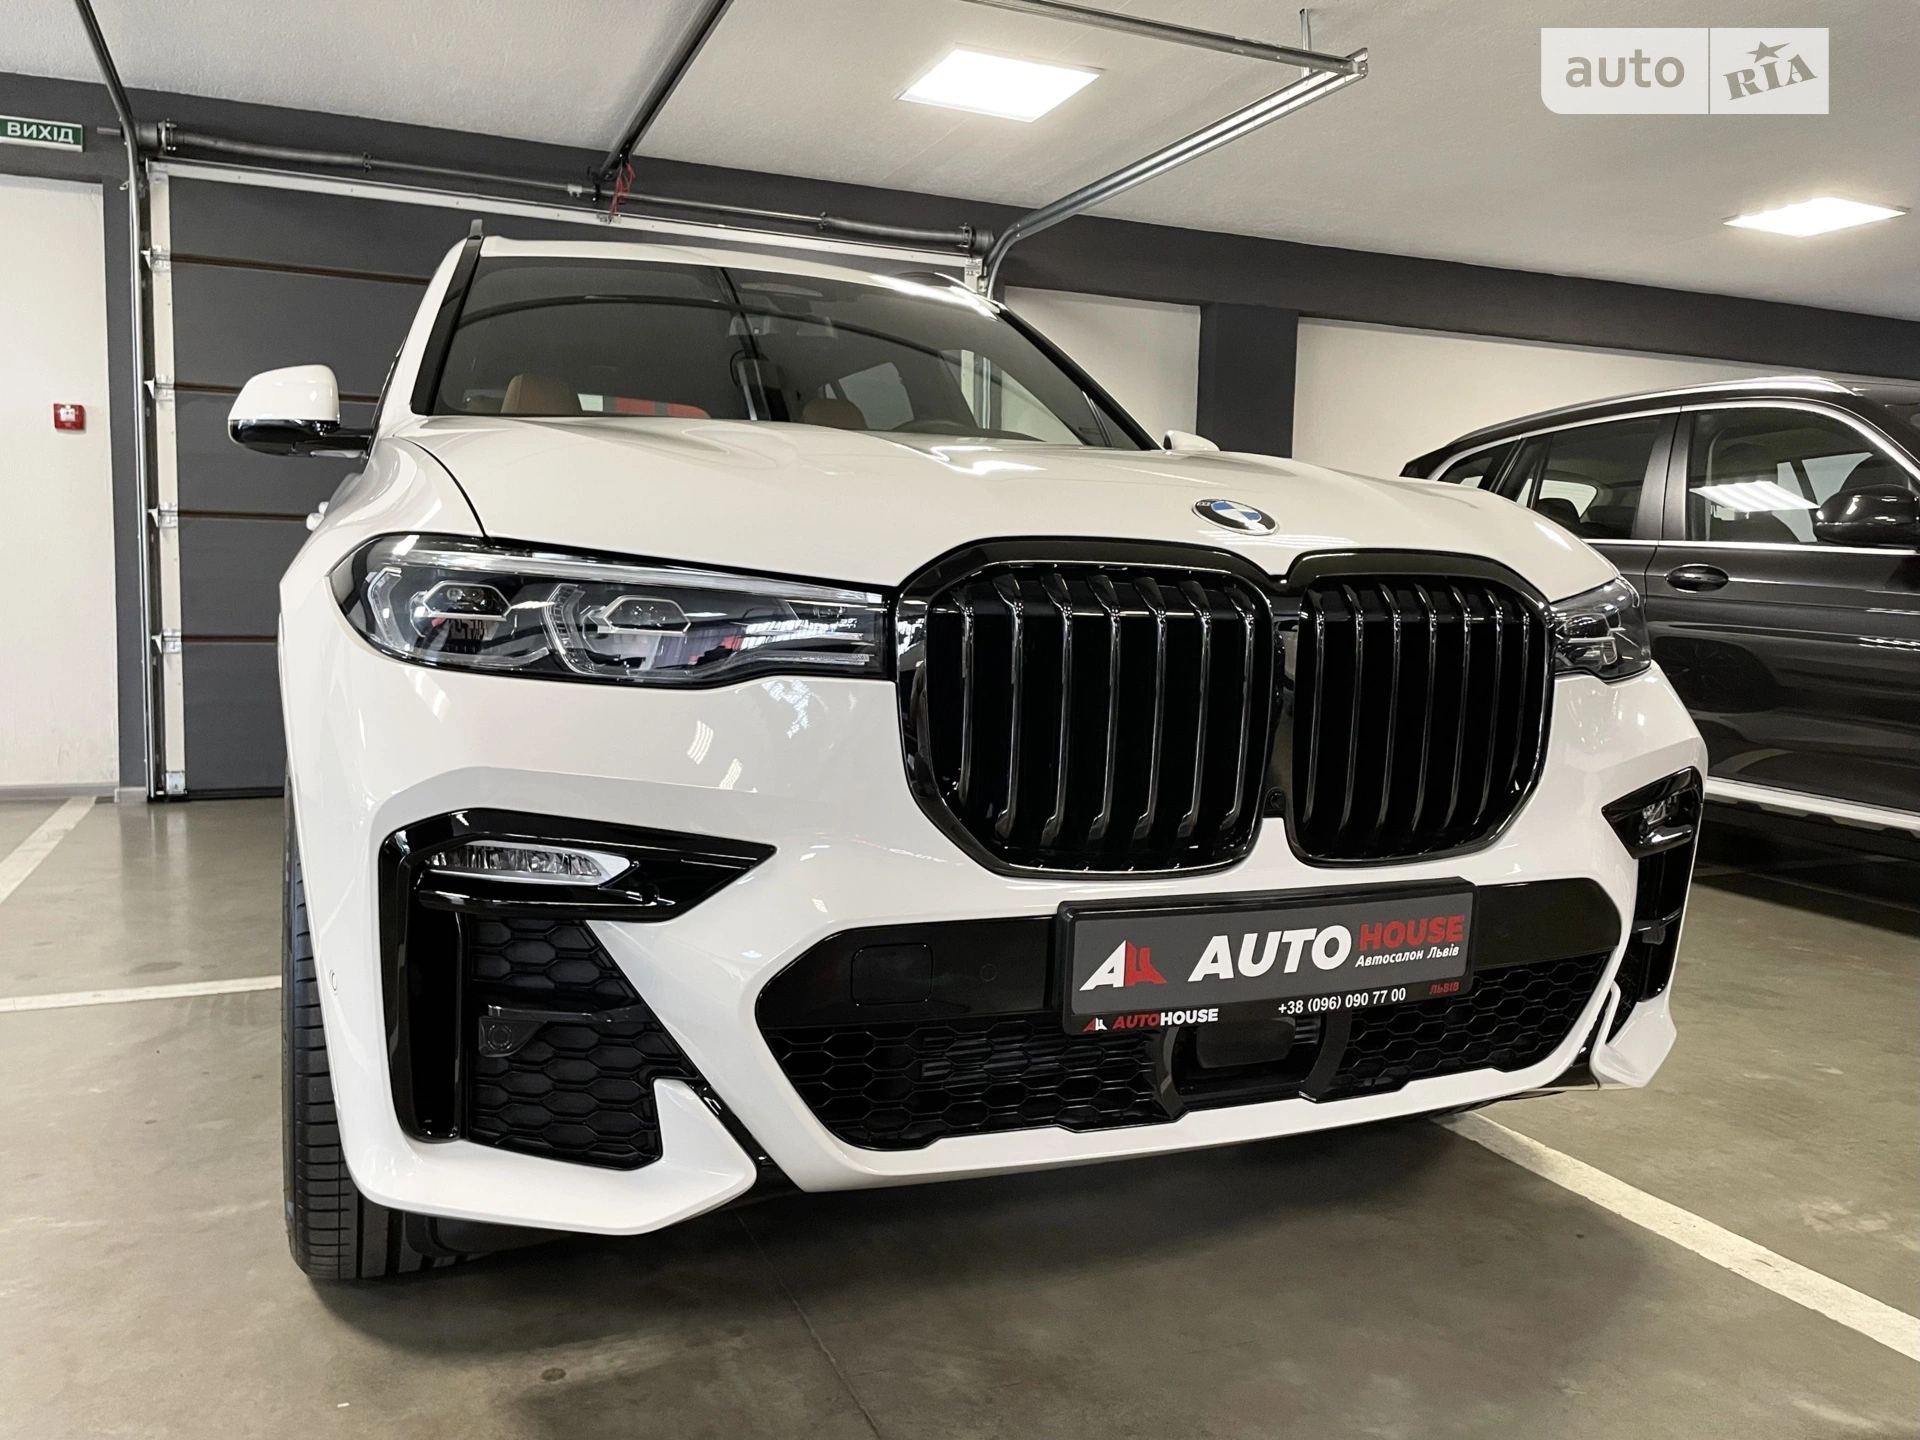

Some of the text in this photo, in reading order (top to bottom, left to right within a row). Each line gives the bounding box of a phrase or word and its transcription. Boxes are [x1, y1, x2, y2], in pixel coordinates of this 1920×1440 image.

[7, 121, 75, 144] ВИХІД
[1187, 924, 1352, 982] AUTO
[1359, 915, 1466, 951] HOUSE
[1355, 943, 1460, 968] Автосалон Львів
[1278, 987, 1407, 1015] +38 (096) 090 77 00
[1112, 1008, 1219, 1030] AUTOHOUSE
